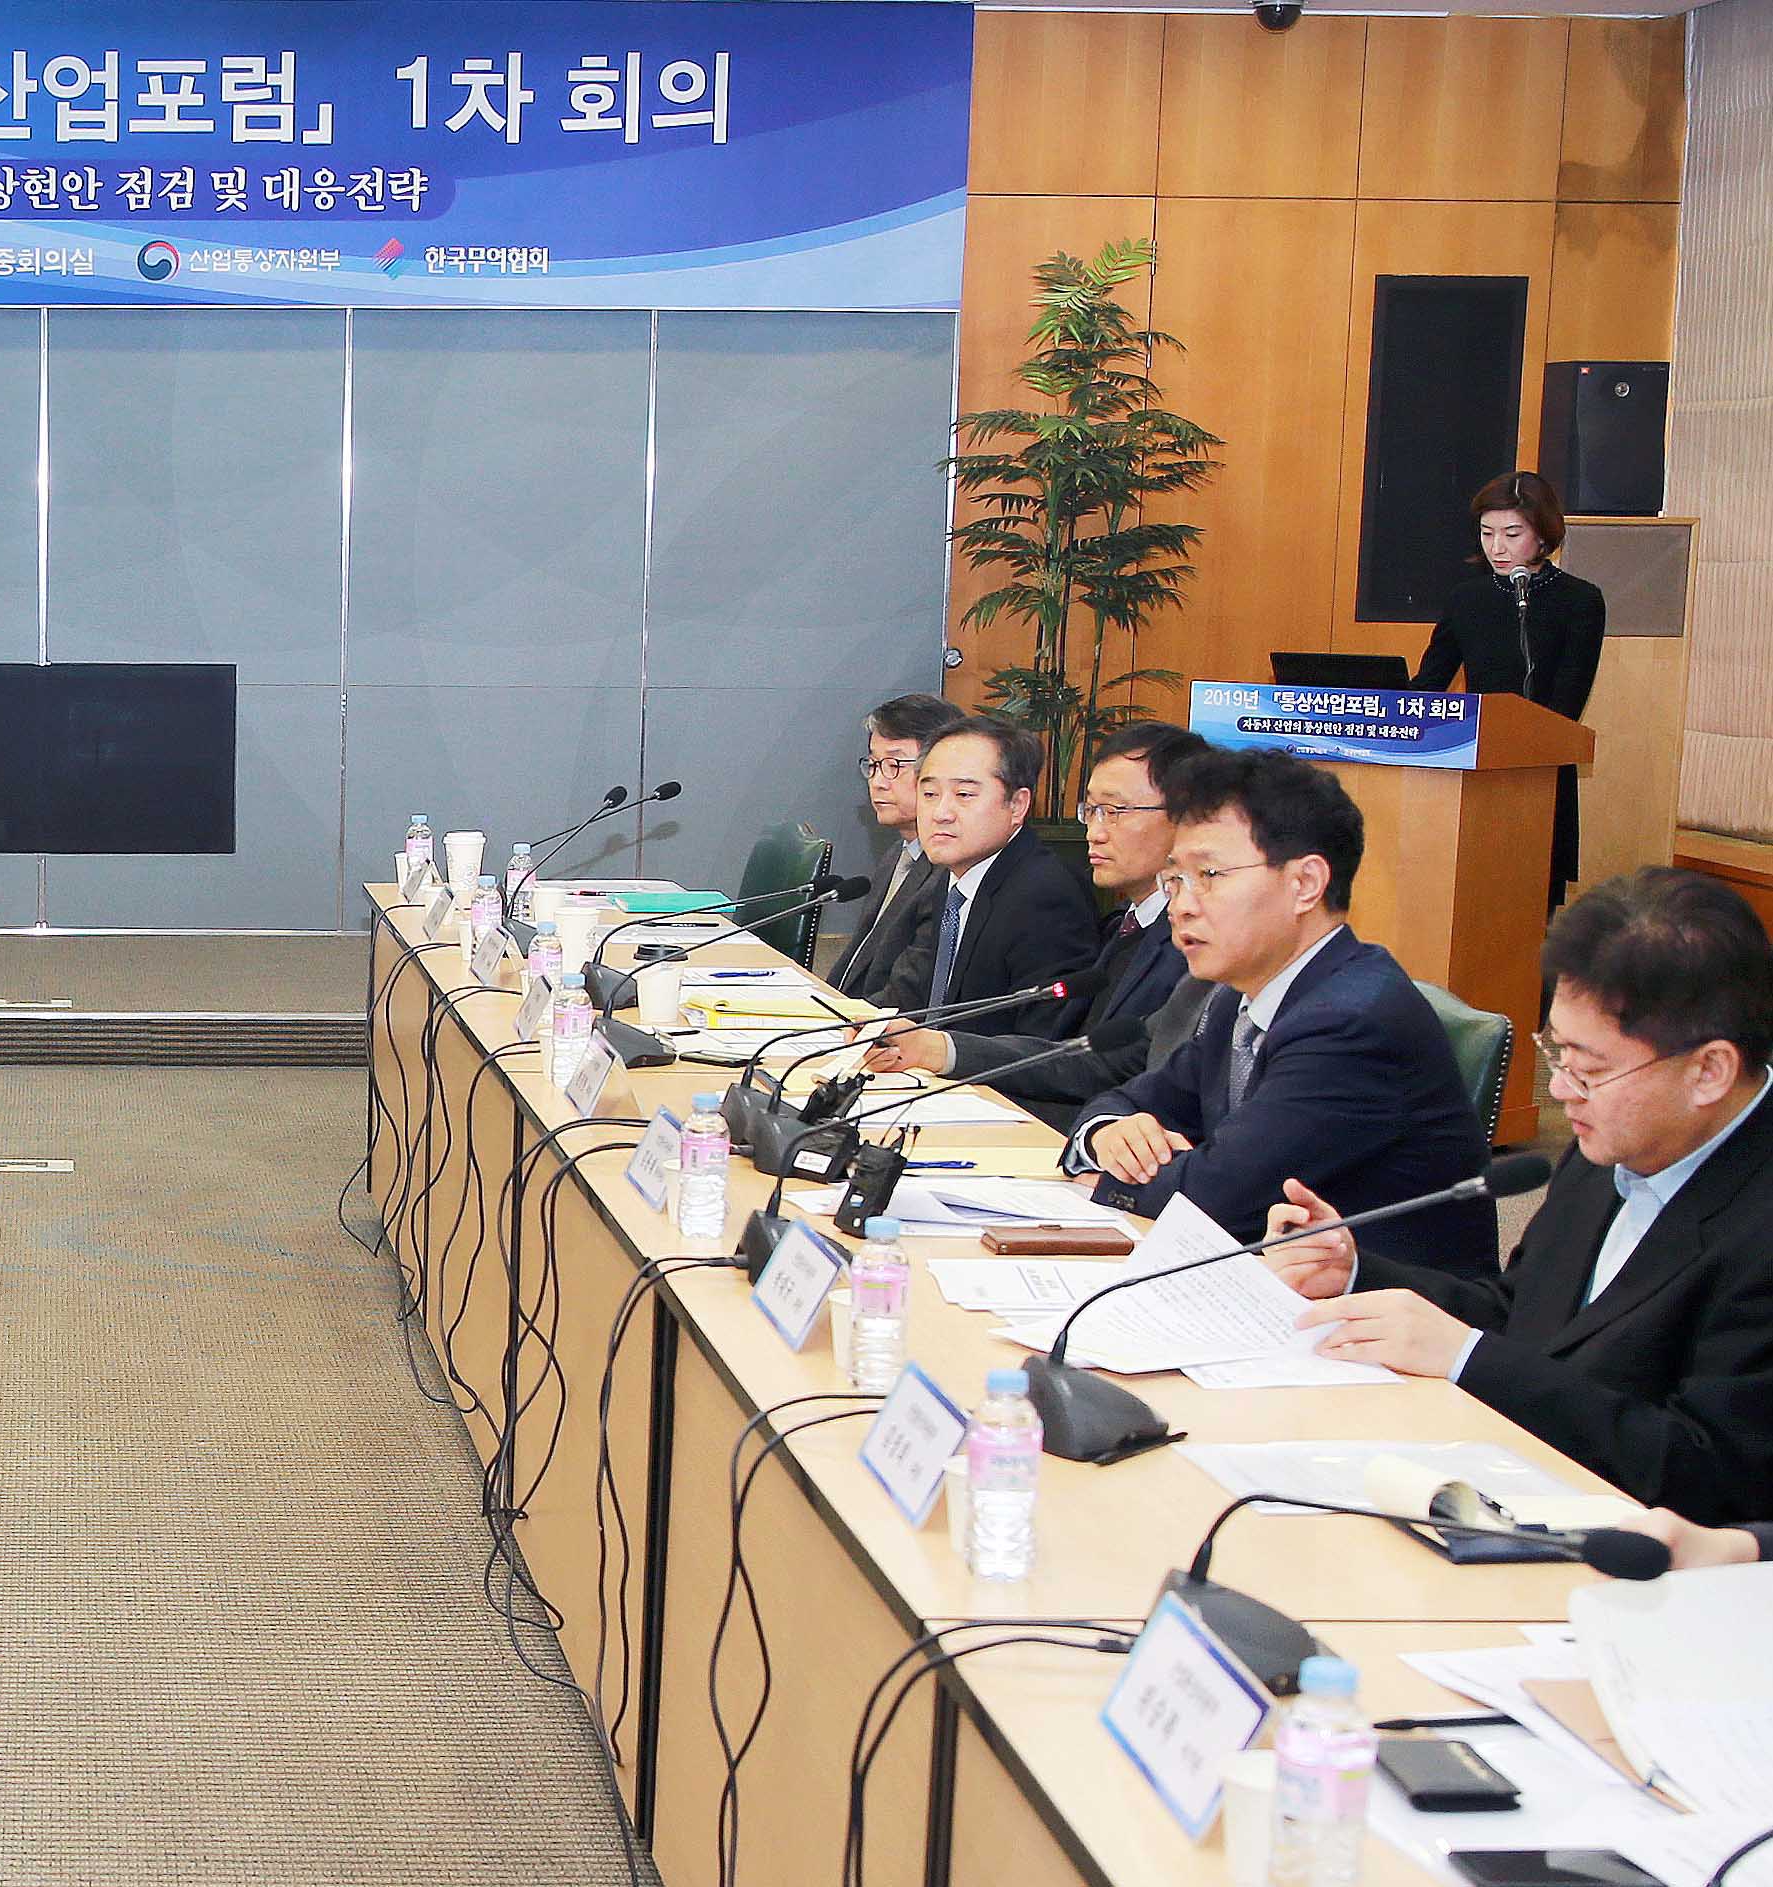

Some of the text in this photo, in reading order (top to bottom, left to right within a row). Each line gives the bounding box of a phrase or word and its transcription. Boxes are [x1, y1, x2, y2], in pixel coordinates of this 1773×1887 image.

[396, 51, 535, 145] 1차
[560, 51, 731, 145] 회의
[115, 165, 196, 212] 점검
[210, 165, 249, 212] 및
[261, 166, 430, 212] 대응전략
[188, 247, 342, 273] 산업통상자원부
[424, 245, 548, 274] 한국무역협회
[1202, 688, 1260, 711] 2019년
[1396, 697, 1426, 719] 1차
[1429, 698, 1466, 721] 회의
